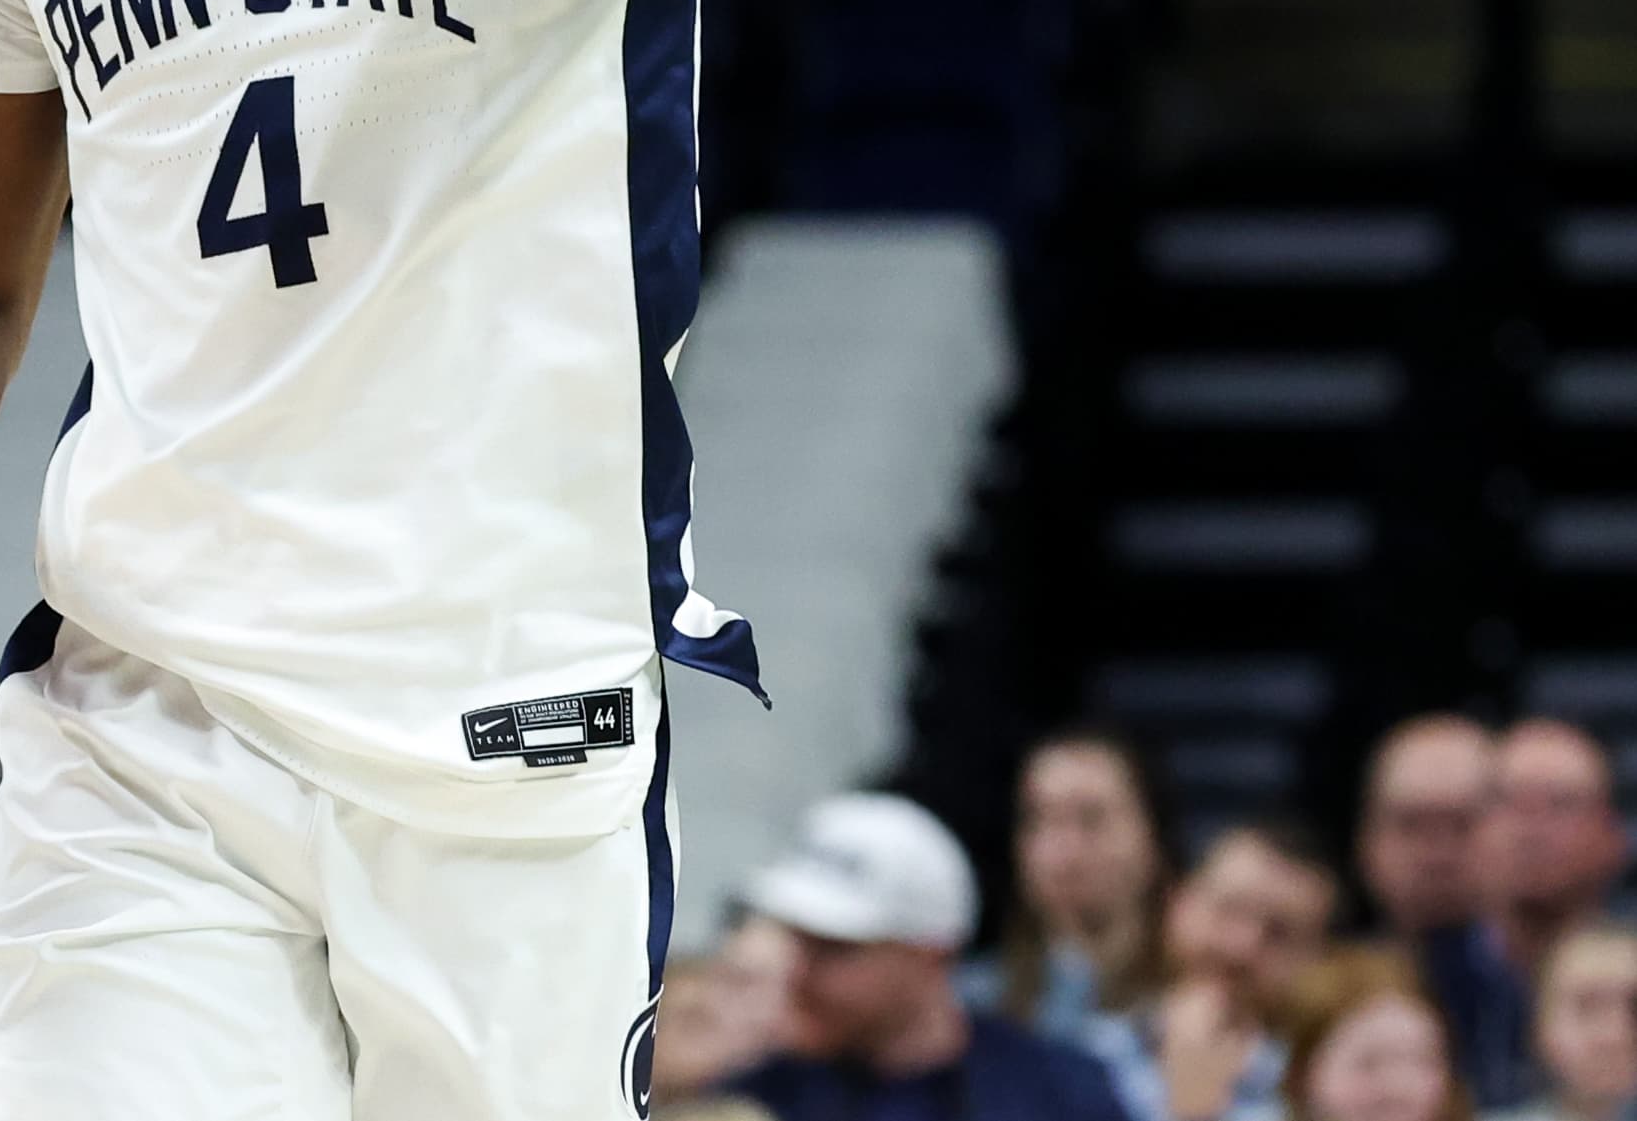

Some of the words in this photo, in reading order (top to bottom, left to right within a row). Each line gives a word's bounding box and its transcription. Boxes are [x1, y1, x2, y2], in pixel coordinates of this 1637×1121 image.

[196, 75, 330, 289] 4
[517, 700, 580, 715] ENGINEERED
[593, 707, 616, 730] 44
[476, 735, 515, 745] TEAM
